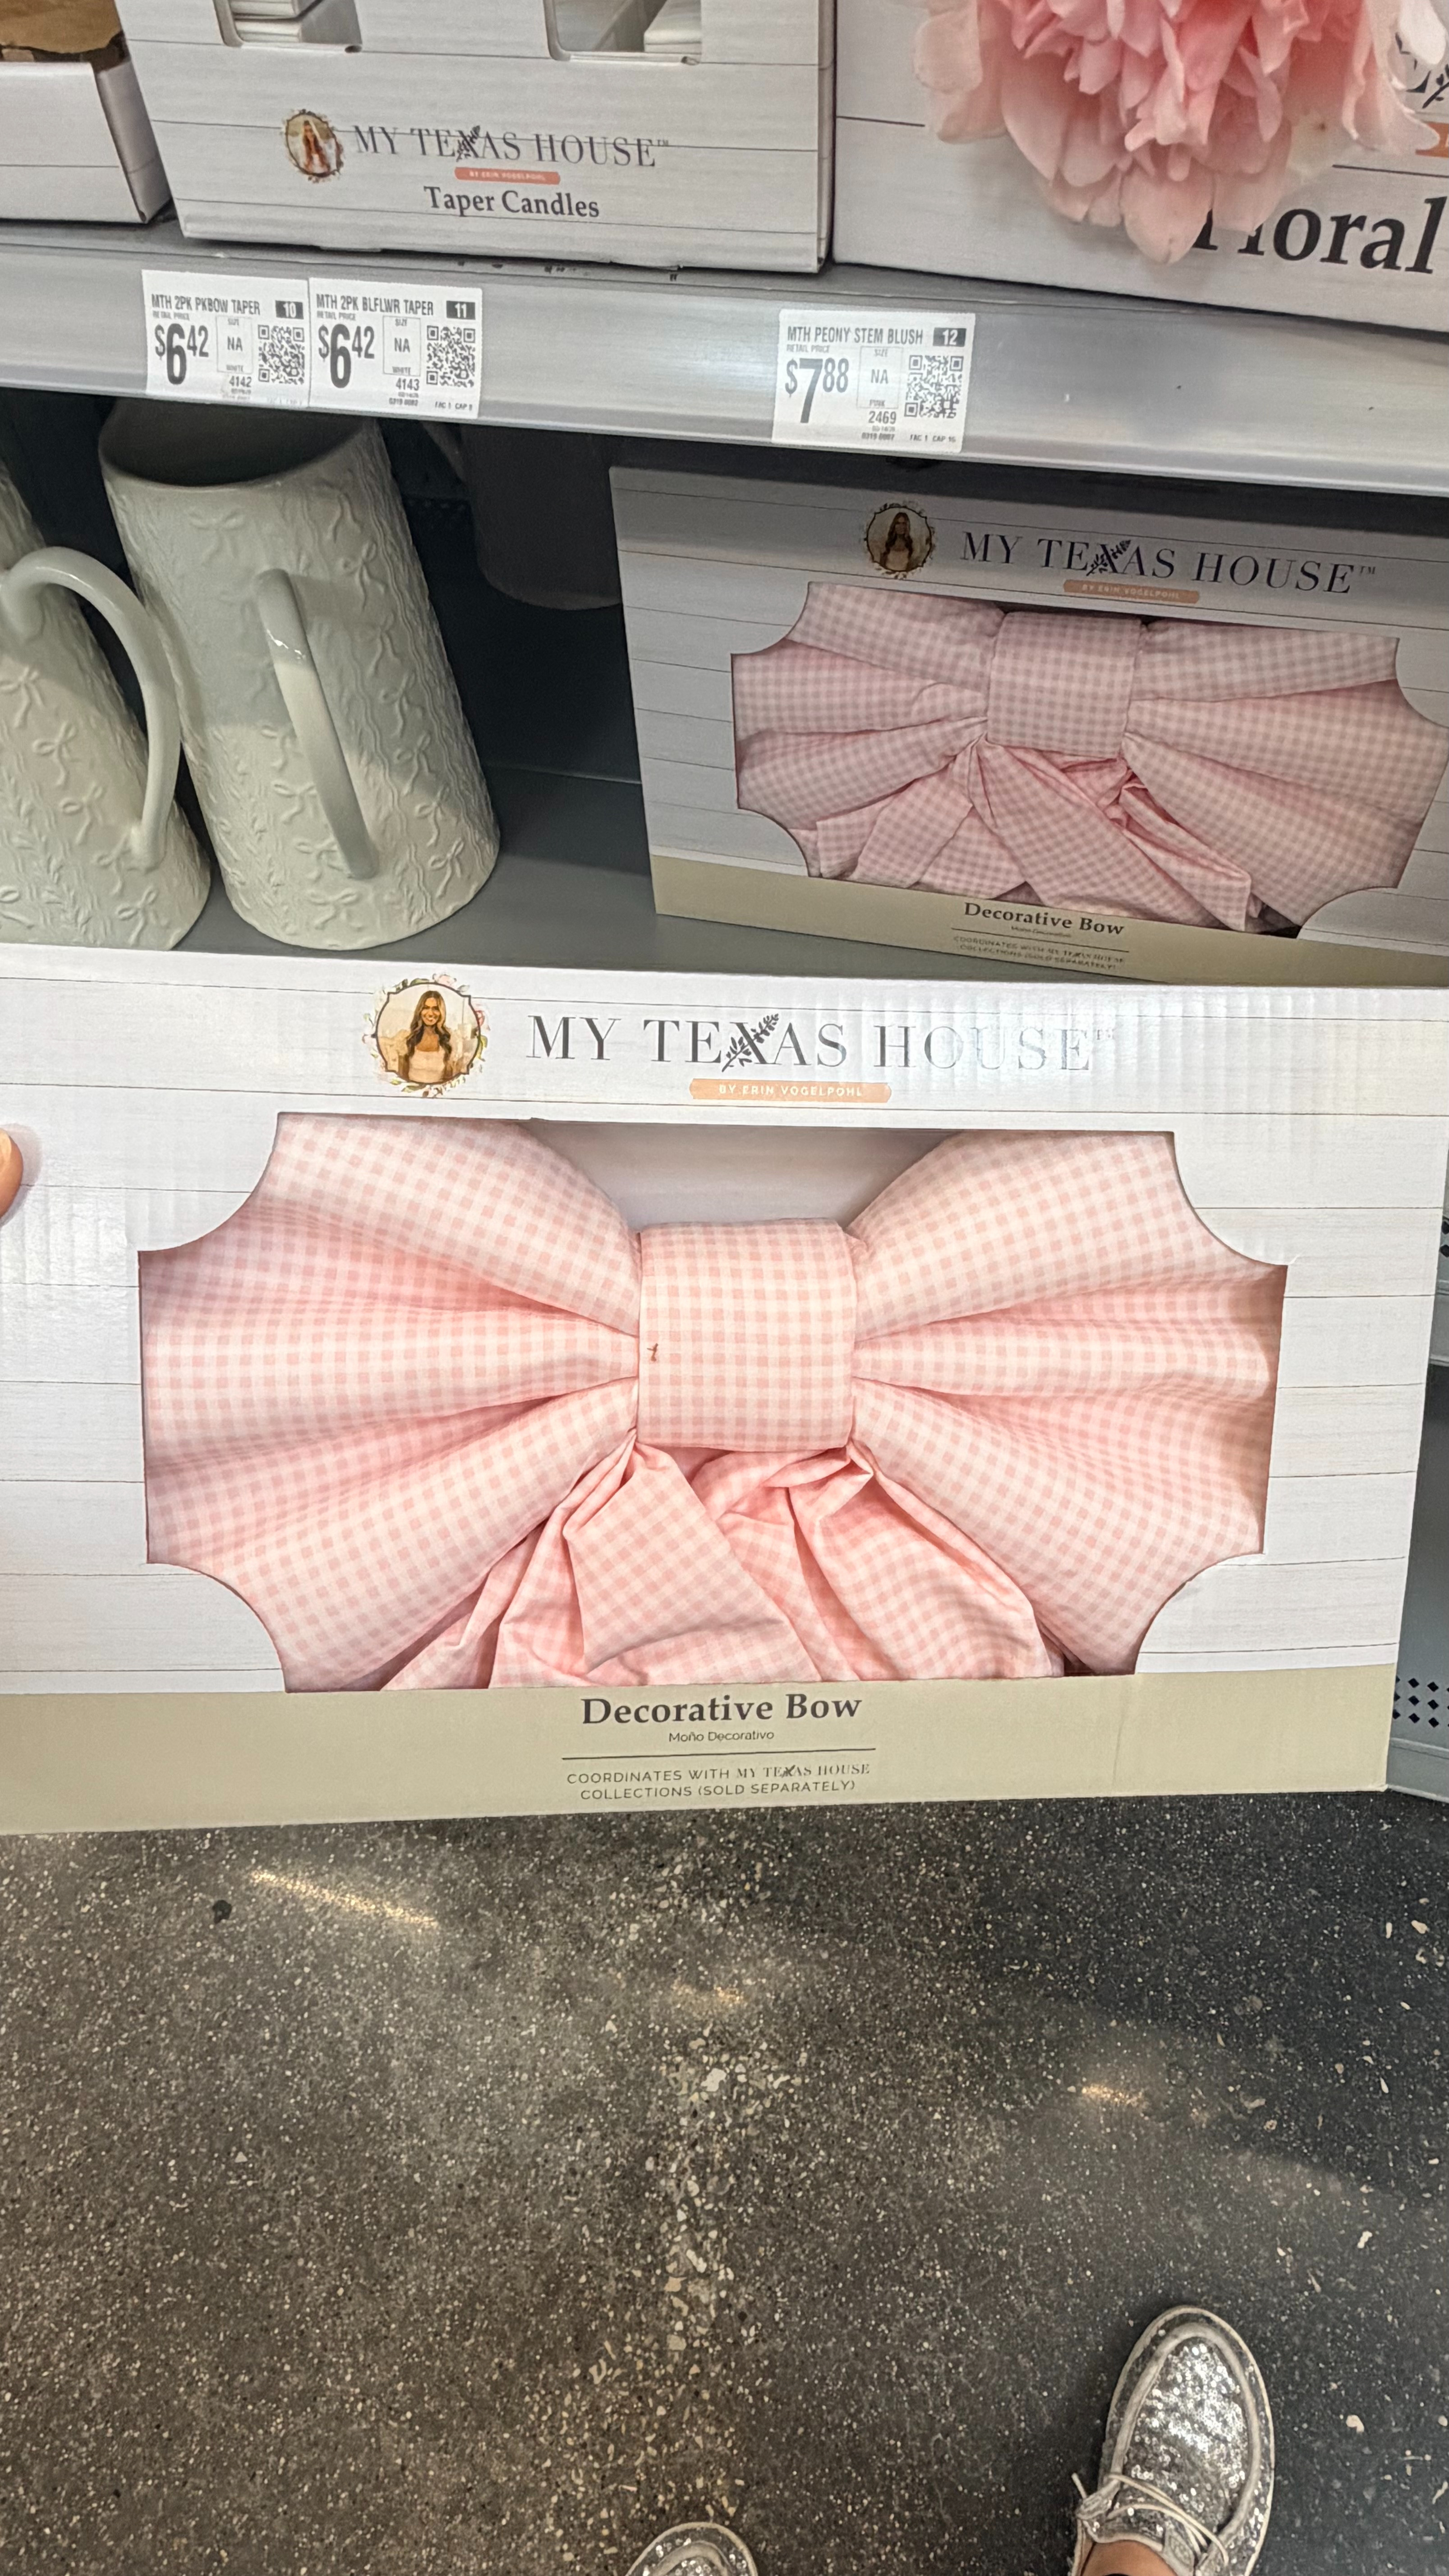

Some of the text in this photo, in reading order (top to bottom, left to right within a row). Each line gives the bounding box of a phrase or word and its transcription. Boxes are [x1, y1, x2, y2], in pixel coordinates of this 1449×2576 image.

[354, 125, 400, 155] MY
[410, 125, 521, 161] TEXAS
[423, 185, 600, 218] Taper Candles
[152, 294, 260, 315] MTH 2PK PKBOW TAPER
[283, 302, 296, 318] 10
[316, 294, 433, 316] MTH 2PK BLFLWR TAPER
[455, 303, 467, 318] 11
[227, 336, 243, 351] NA
[787, 326, 923, 345] MTH PEONY STEM BLUSH
[942, 329, 957, 345] 12
[394, 337, 410, 353] NA
[229, 376, 252, 387] 4142
[396, 377, 419, 391] 4143
[870, 369, 888, 384] NA
[868, 410, 897, 424] 2469
[961, 531, 1023, 565] MY
[1037, 538, 1176, 579] TEXAS
[964, 902, 1072, 929] Decorative
[1080, 917, 1125, 935] Bow
[526, 1014, 621, 1061] MY
[644, 1012, 846, 1072] TEXAS
[719, 1084, 862, 1096] BY ERIN VOGELPOHL
[580, 1693, 863, 1725] Decorative Bow
[669, 1730, 775, 1743] Moño Decorativo
[567, 1762, 870, 1784] COORDINATES WITH MY TEXAS HOUSE
[580, 1780, 856, 1800] COLLECTIONS (SOLD SEPARATELY)
